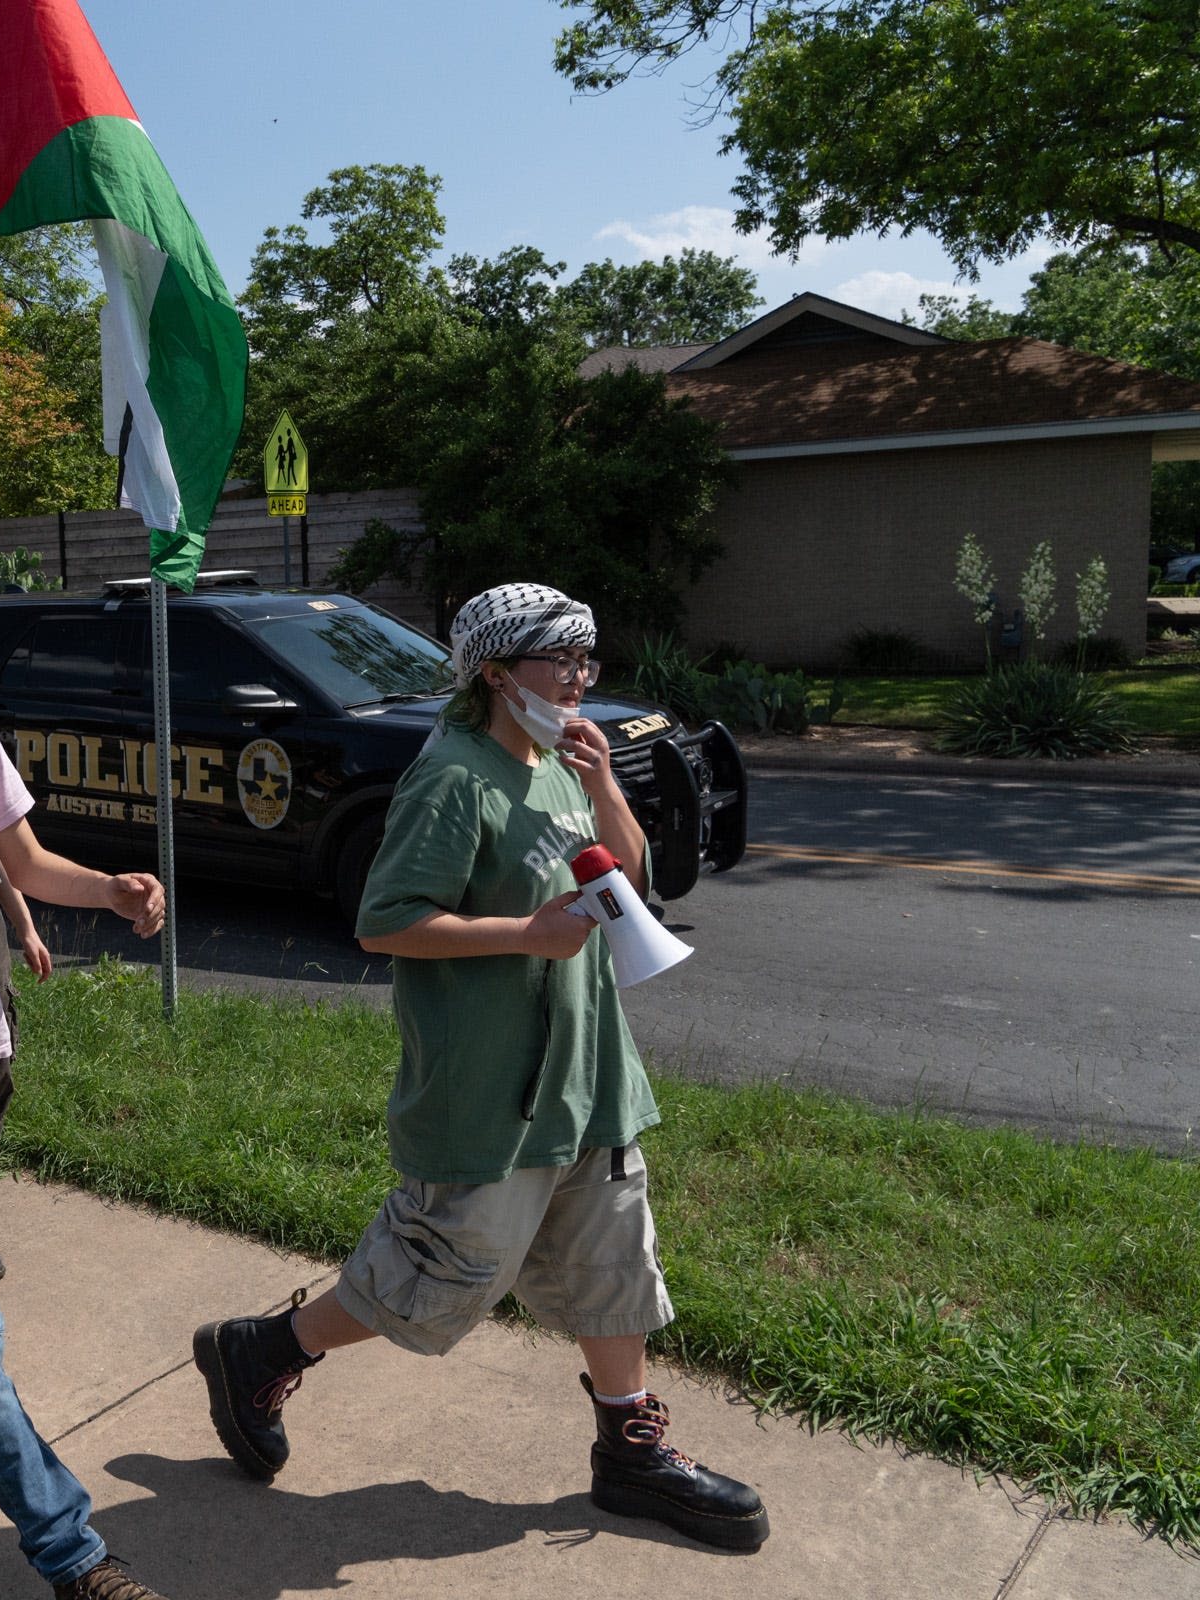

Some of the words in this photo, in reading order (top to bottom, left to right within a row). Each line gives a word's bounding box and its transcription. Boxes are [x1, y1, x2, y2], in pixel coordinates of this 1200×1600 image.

[271, 499, 304, 511] AHEAD
[14, 729, 223, 804] POLICE
[47, 793, 126, 821] AUSTIN
[132, 803, 158, 825] IS
